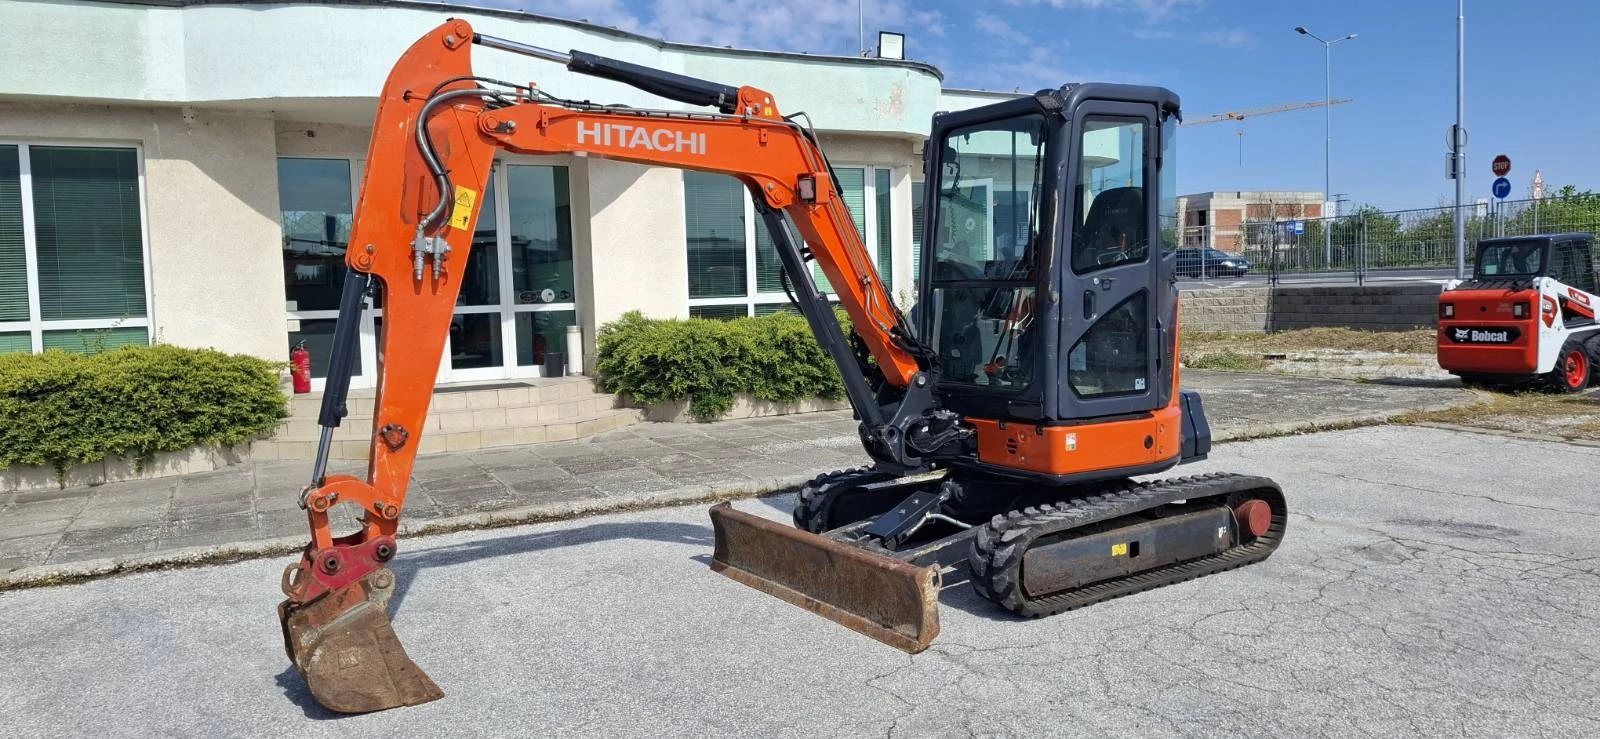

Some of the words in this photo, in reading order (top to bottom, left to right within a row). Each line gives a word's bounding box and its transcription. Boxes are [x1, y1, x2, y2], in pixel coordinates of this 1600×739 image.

[577, 120, 706, 155] HITACHI
[1494, 161, 1509, 171] STOP
[1472, 330, 1508, 342] Bobcat
